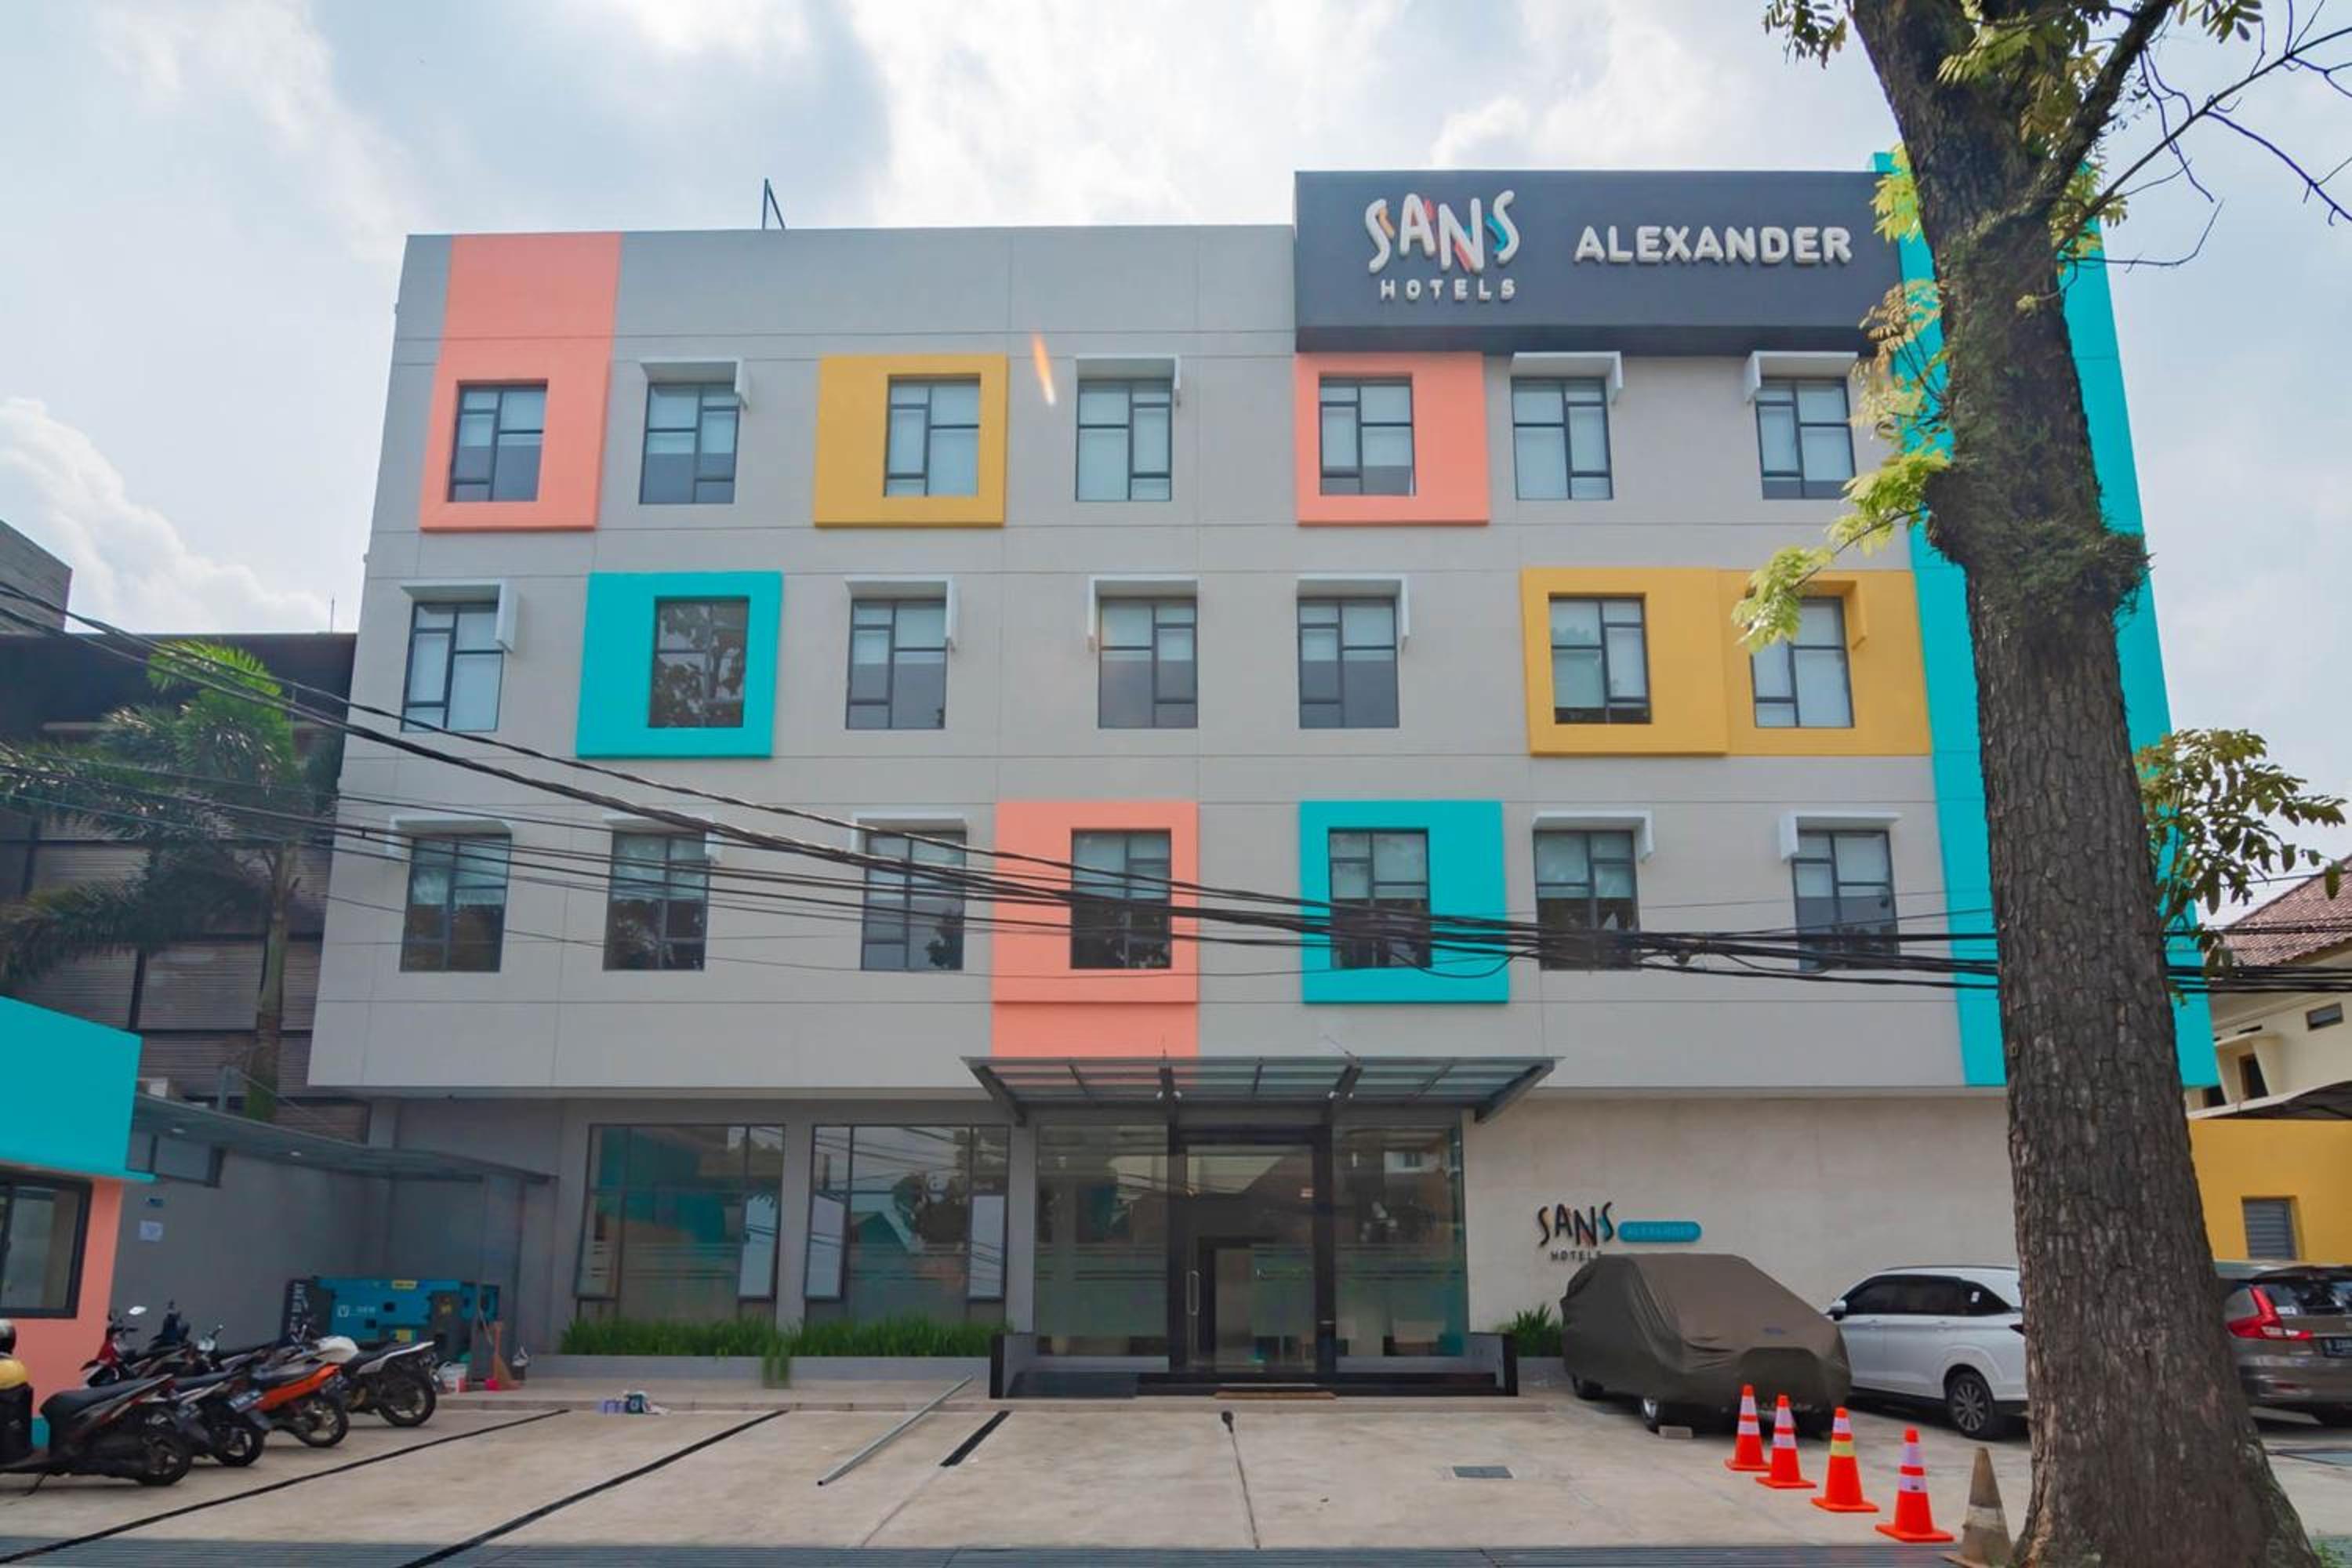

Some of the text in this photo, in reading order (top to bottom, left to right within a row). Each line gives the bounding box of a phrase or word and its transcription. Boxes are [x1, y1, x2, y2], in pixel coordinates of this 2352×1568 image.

[1365, 190, 1520, 274] SANS
[1574, 225, 1852, 263] ALEXANDER
[1380, 278, 1515, 301] HOTELS
[1537, 1201, 1613, 1247] SANS
